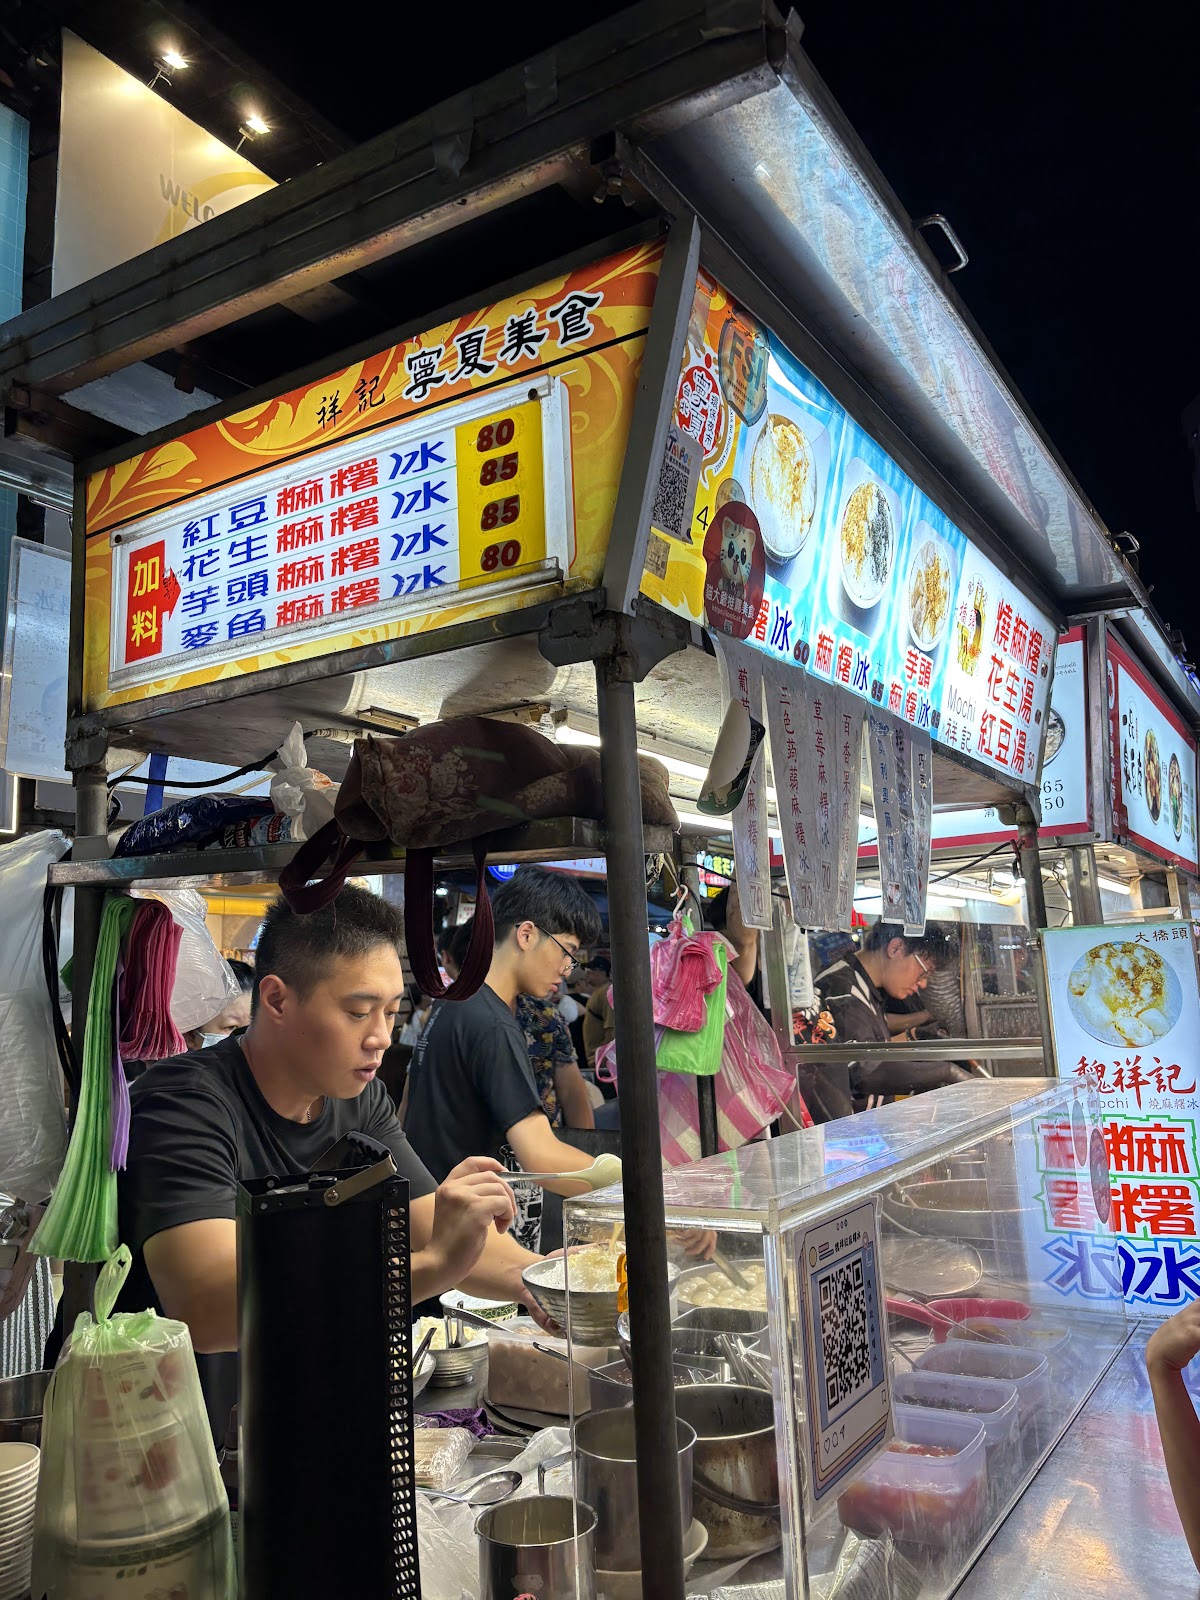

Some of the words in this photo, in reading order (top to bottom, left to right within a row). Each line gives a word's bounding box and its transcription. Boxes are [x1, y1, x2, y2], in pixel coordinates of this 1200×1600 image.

[315, 375, 385, 430] 祥記
[404, 293, 602, 400] 寧夏美食
[476, 417, 515, 453] 80
[182, 480, 450, 583] 花生麻糬冰
[479, 452, 519, 487] 85
[696, 506, 709, 531] 4
[181, 523, 450, 618] 芋頭麻糬冰
[481, 494, 520, 532] 85
[481, 539, 521, 572] 80
[131, 556, 160, 647] 加料
[800, 616, 809, 635] 小
[993, 599, 1042, 676] 燒麻糬
[793, 638, 810, 665] 60
[814, 630, 871, 692] 麻糬冰
[876, 659, 883, 675] 大
[904, 648, 933, 690] 芋頭
[871, 679, 884, 702] 85
[947, 684, 976, 724] Mochi
[987, 652, 1035, 726] 花生湯
[931, 709, 941, 730] 85
[977, 709, 1027, 776] 紅豆湯
[1044, 796, 1065, 810] 50
[1134, 927, 1189, 943] 大橋頭
[1072, 1054, 1197, 1111] 魏祥記
